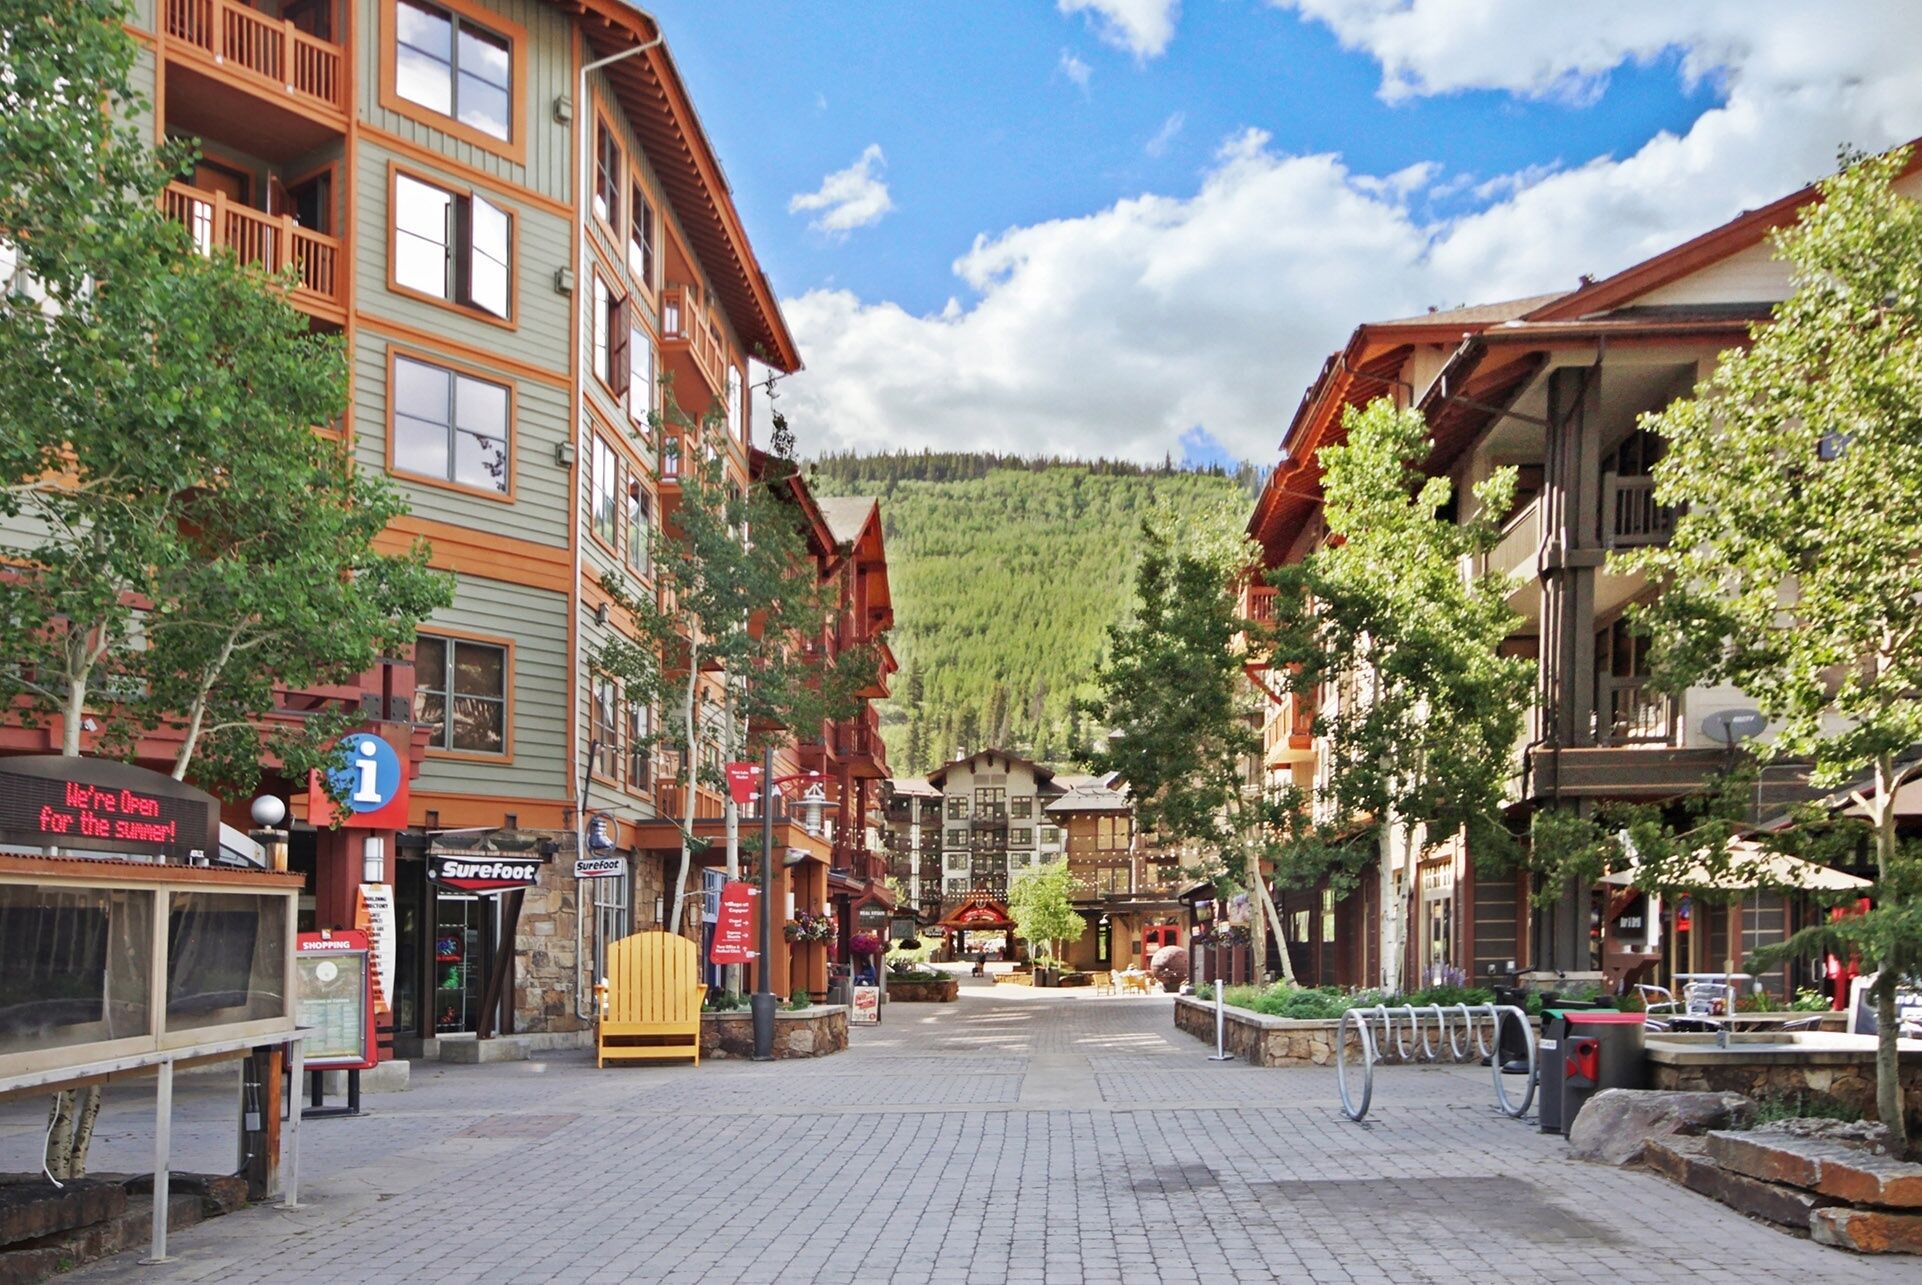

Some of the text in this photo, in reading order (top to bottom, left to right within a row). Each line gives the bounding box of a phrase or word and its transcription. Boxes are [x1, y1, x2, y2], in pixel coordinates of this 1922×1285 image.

[65, 780, 159, 817] We're Open
[40, 804, 177, 842] for the summer!
[441, 861, 535, 880] Surefoot
[577, 860, 620, 871] Surefoot
[302, 941, 351, 950] SHOPPING
